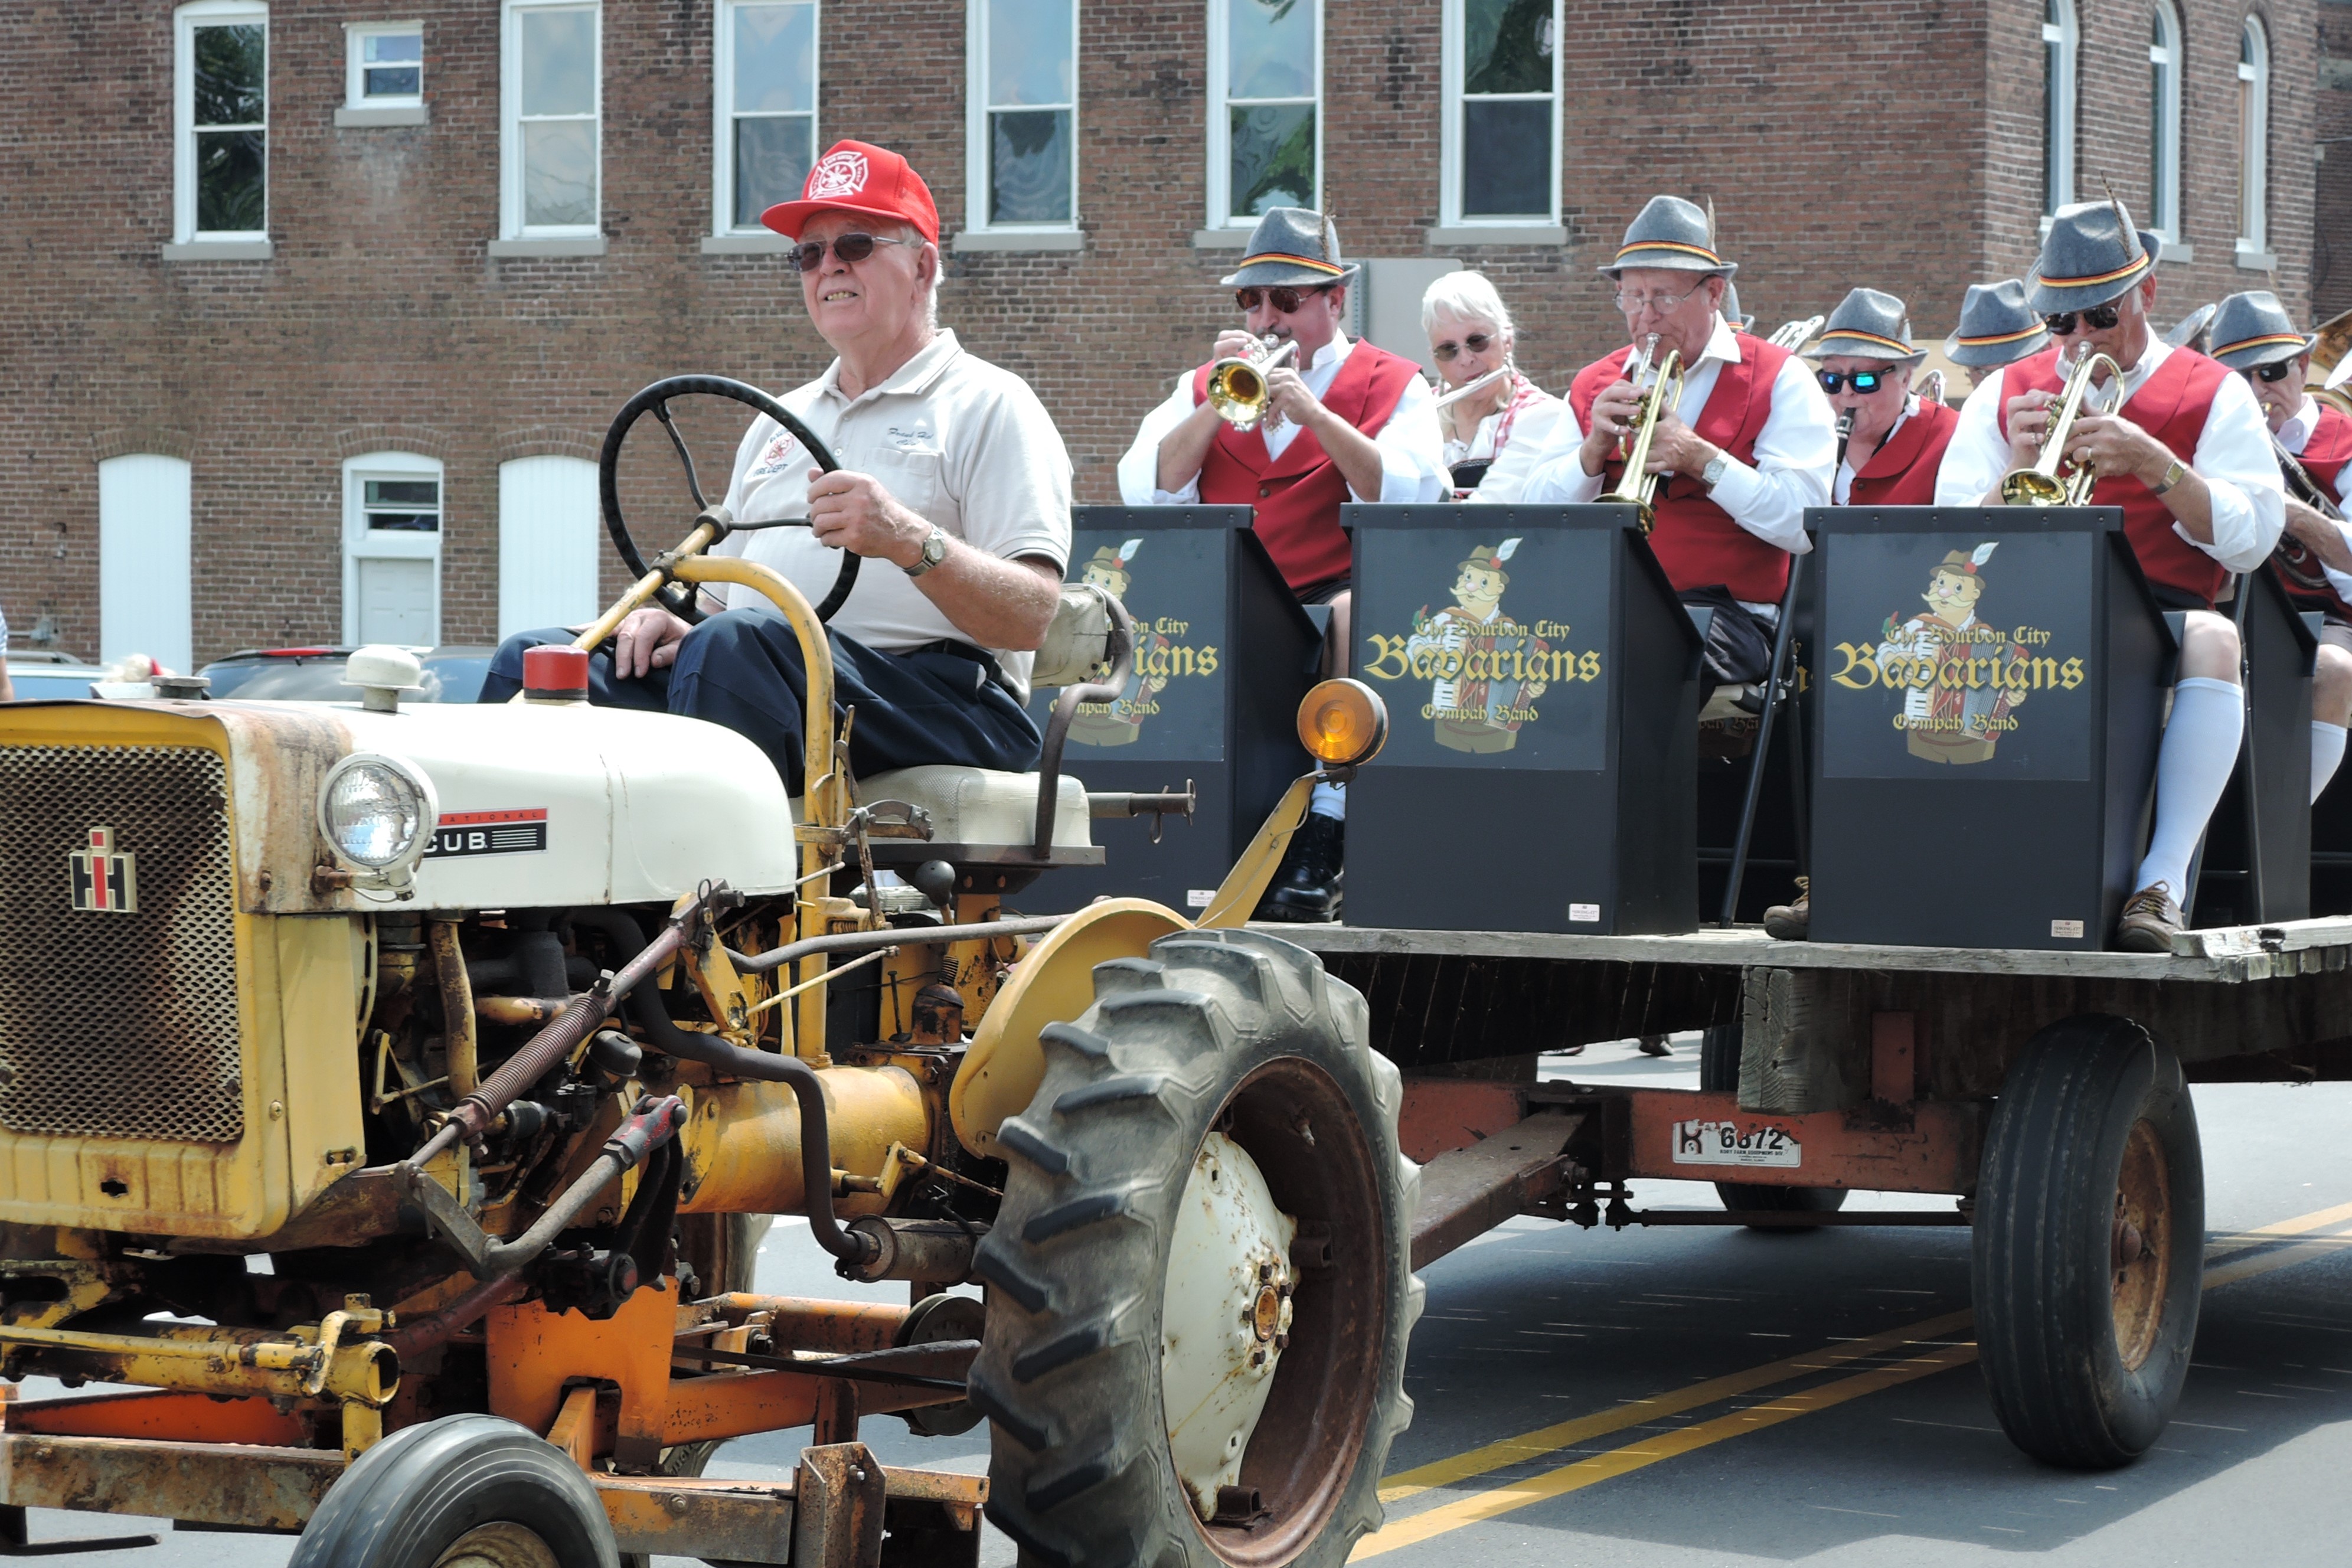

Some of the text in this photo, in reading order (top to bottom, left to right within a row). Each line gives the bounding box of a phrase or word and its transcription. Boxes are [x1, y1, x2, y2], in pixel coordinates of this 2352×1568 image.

[1155, 617, 1189, 638] City
[1416, 618, 1570, 642] The Bourbon City
[1885, 625, 2052, 648] The Bourbon City
[1363, 633, 1602, 682] Bavarians
[1830, 641, 2085, 691] Bavarians
[1118, 699, 1161, 716] Band
[1421, 703, 1539, 723] Oompah Band
[1892, 713, 2019, 734] Oompah Band
[439, 812, 537, 823] ATIONAL
